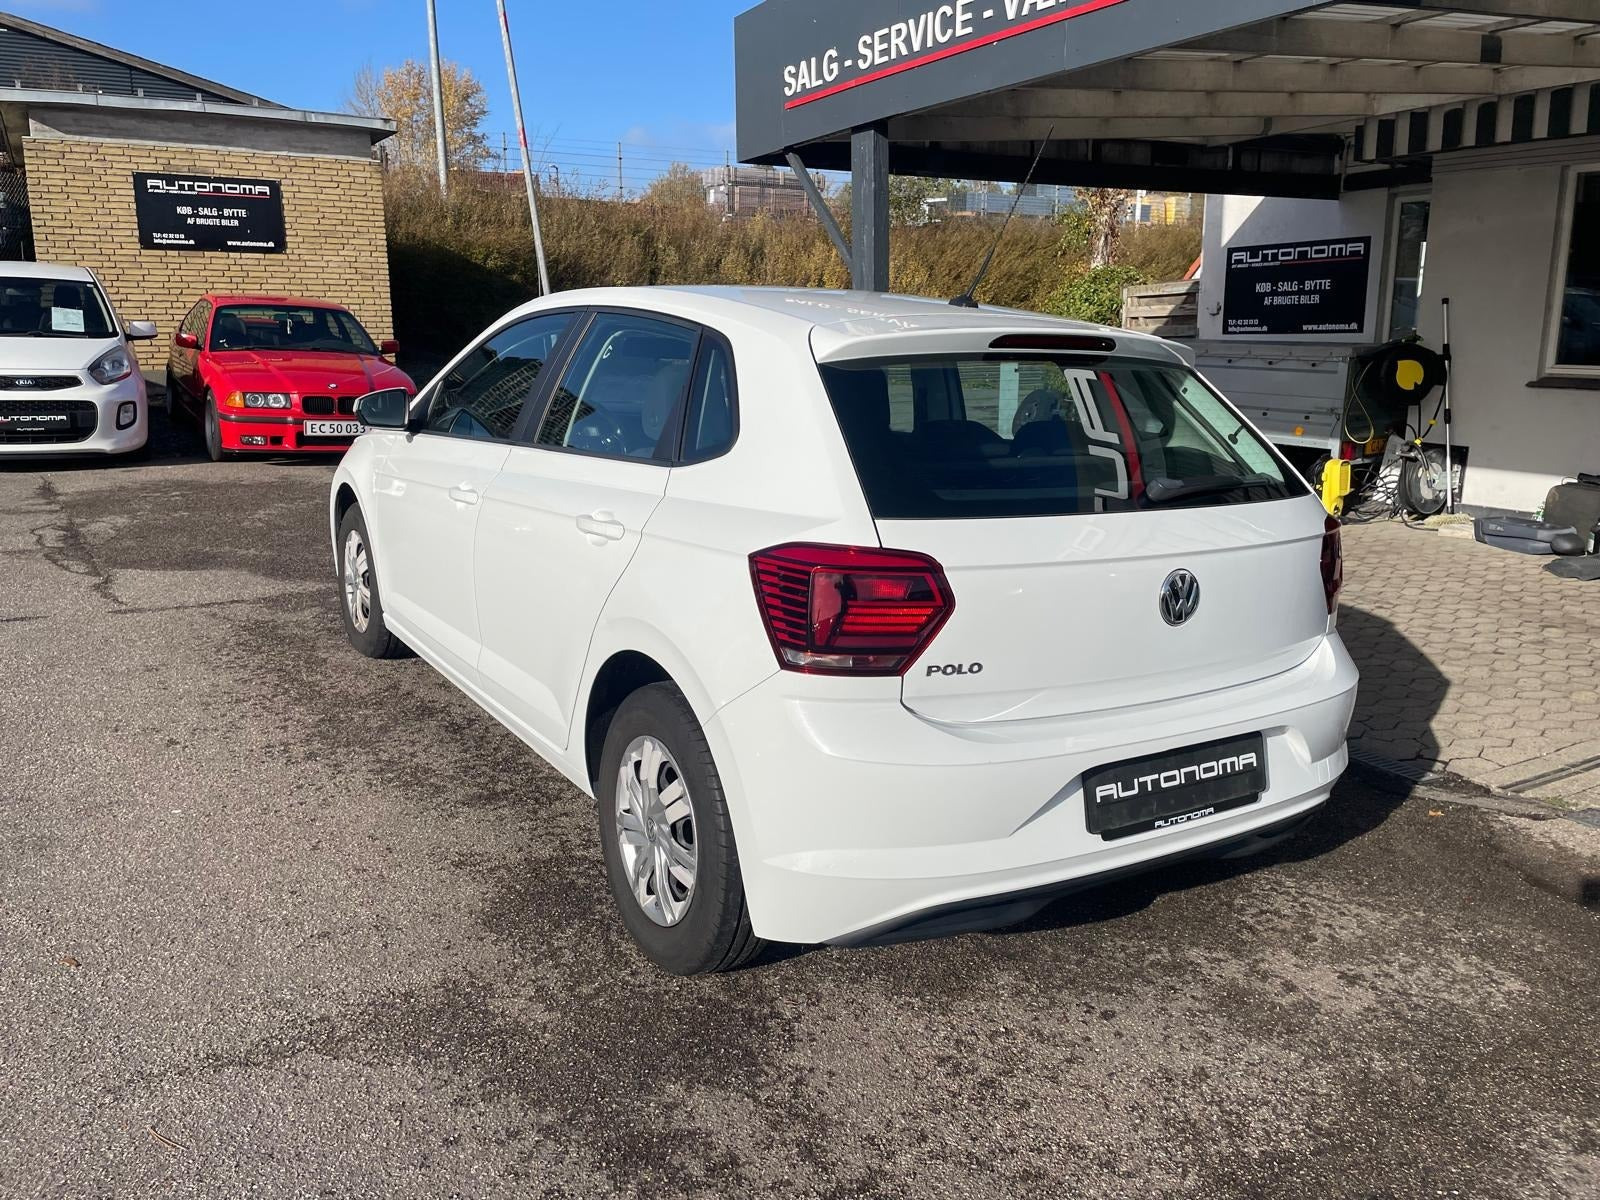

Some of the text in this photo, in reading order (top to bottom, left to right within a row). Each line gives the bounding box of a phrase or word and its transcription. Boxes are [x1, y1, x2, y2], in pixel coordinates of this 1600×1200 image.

[784, 50, 838, 96] SALG
[858, 0, 974, 70] SERVICE
[147, 180, 270, 195] AUTONOMA
[177, 206, 193, 215] KØB
[198, 207, 218, 216] SALG
[223, 208, 247, 217] BYTTE
[187, 217, 239, 227] AF BRUGTE BILER
[227, 240, 275, 248] www.autonoma.dk
[1232, 243, 1364, 264] AUTONOMA
[1256, 282, 1271, 293] KØB
[1278, 281, 1298, 292] SALG
[1305, 279, 1331, 290] BYTTE
[1264, 294, 1320, 305] AF BRUGTE BILER
[1303, 322, 1358, 331] www.autonoma.dk
[311, 423, 366, 434] EC 50 033
[926, 661, 984, 677] POLO
[1096, 752, 1257, 803] AUTONOMA
[1154, 807, 1214, 828] AUTONOMA
